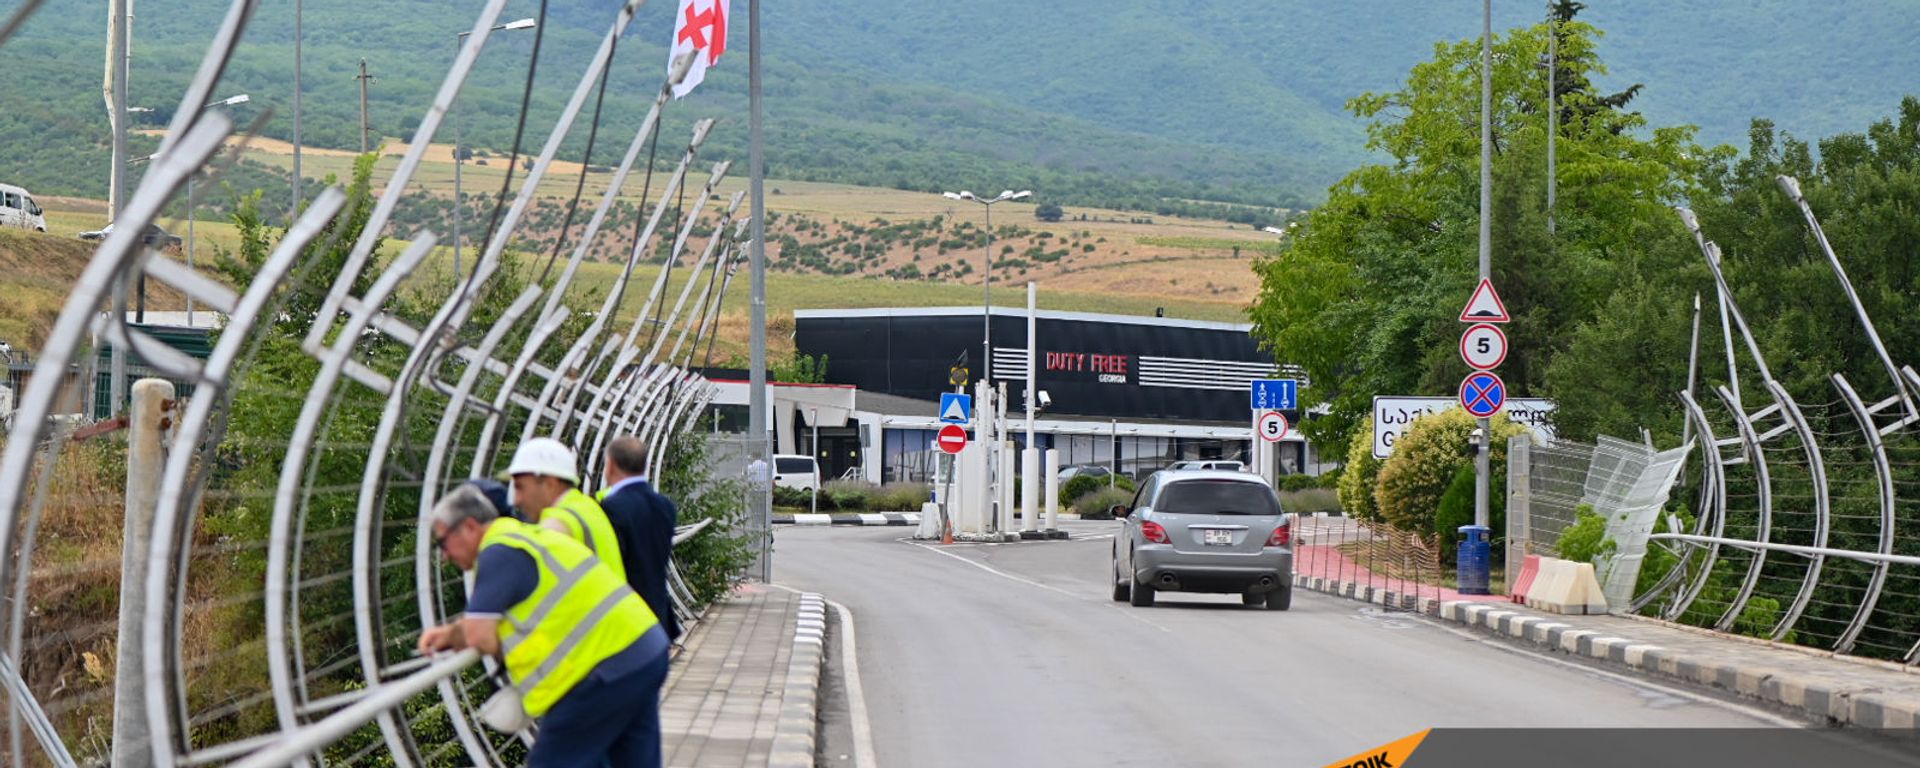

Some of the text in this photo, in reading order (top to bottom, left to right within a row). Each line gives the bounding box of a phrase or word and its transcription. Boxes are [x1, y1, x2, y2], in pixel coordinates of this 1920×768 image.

[1477, 337, 1490, 354] 5
[1046, 351, 1129, 374] DUTY FREE
[1098, 373, 1127, 384] GEORGIA
[1268, 421, 1278, 434] 5
